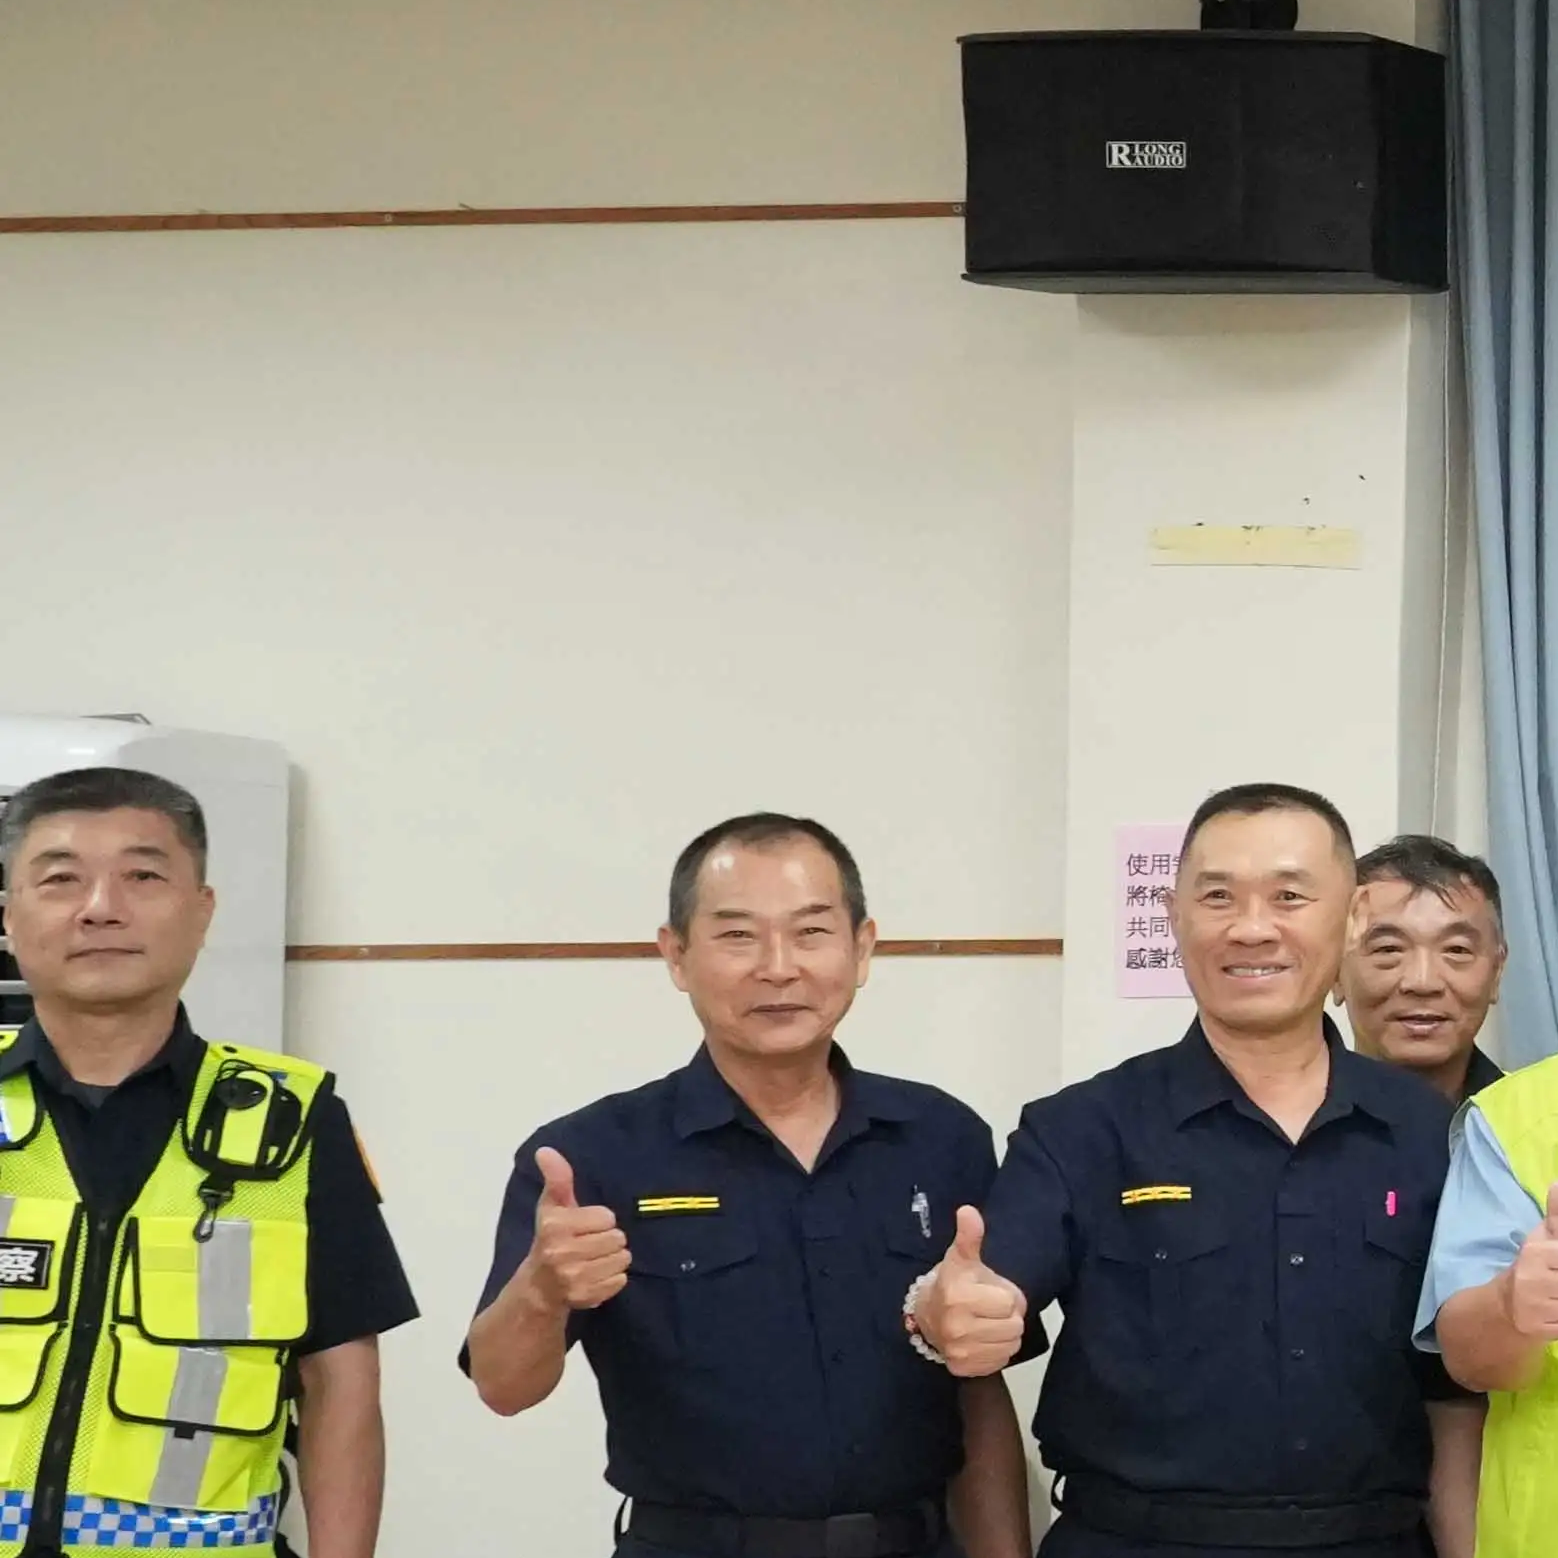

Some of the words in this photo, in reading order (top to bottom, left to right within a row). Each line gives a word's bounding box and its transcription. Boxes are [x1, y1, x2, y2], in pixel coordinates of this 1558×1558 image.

[1132, 144, 1181, 156] LONG
[1132, 154, 1183, 166] AUDIO
[1126, 916, 1170, 939] 共同
